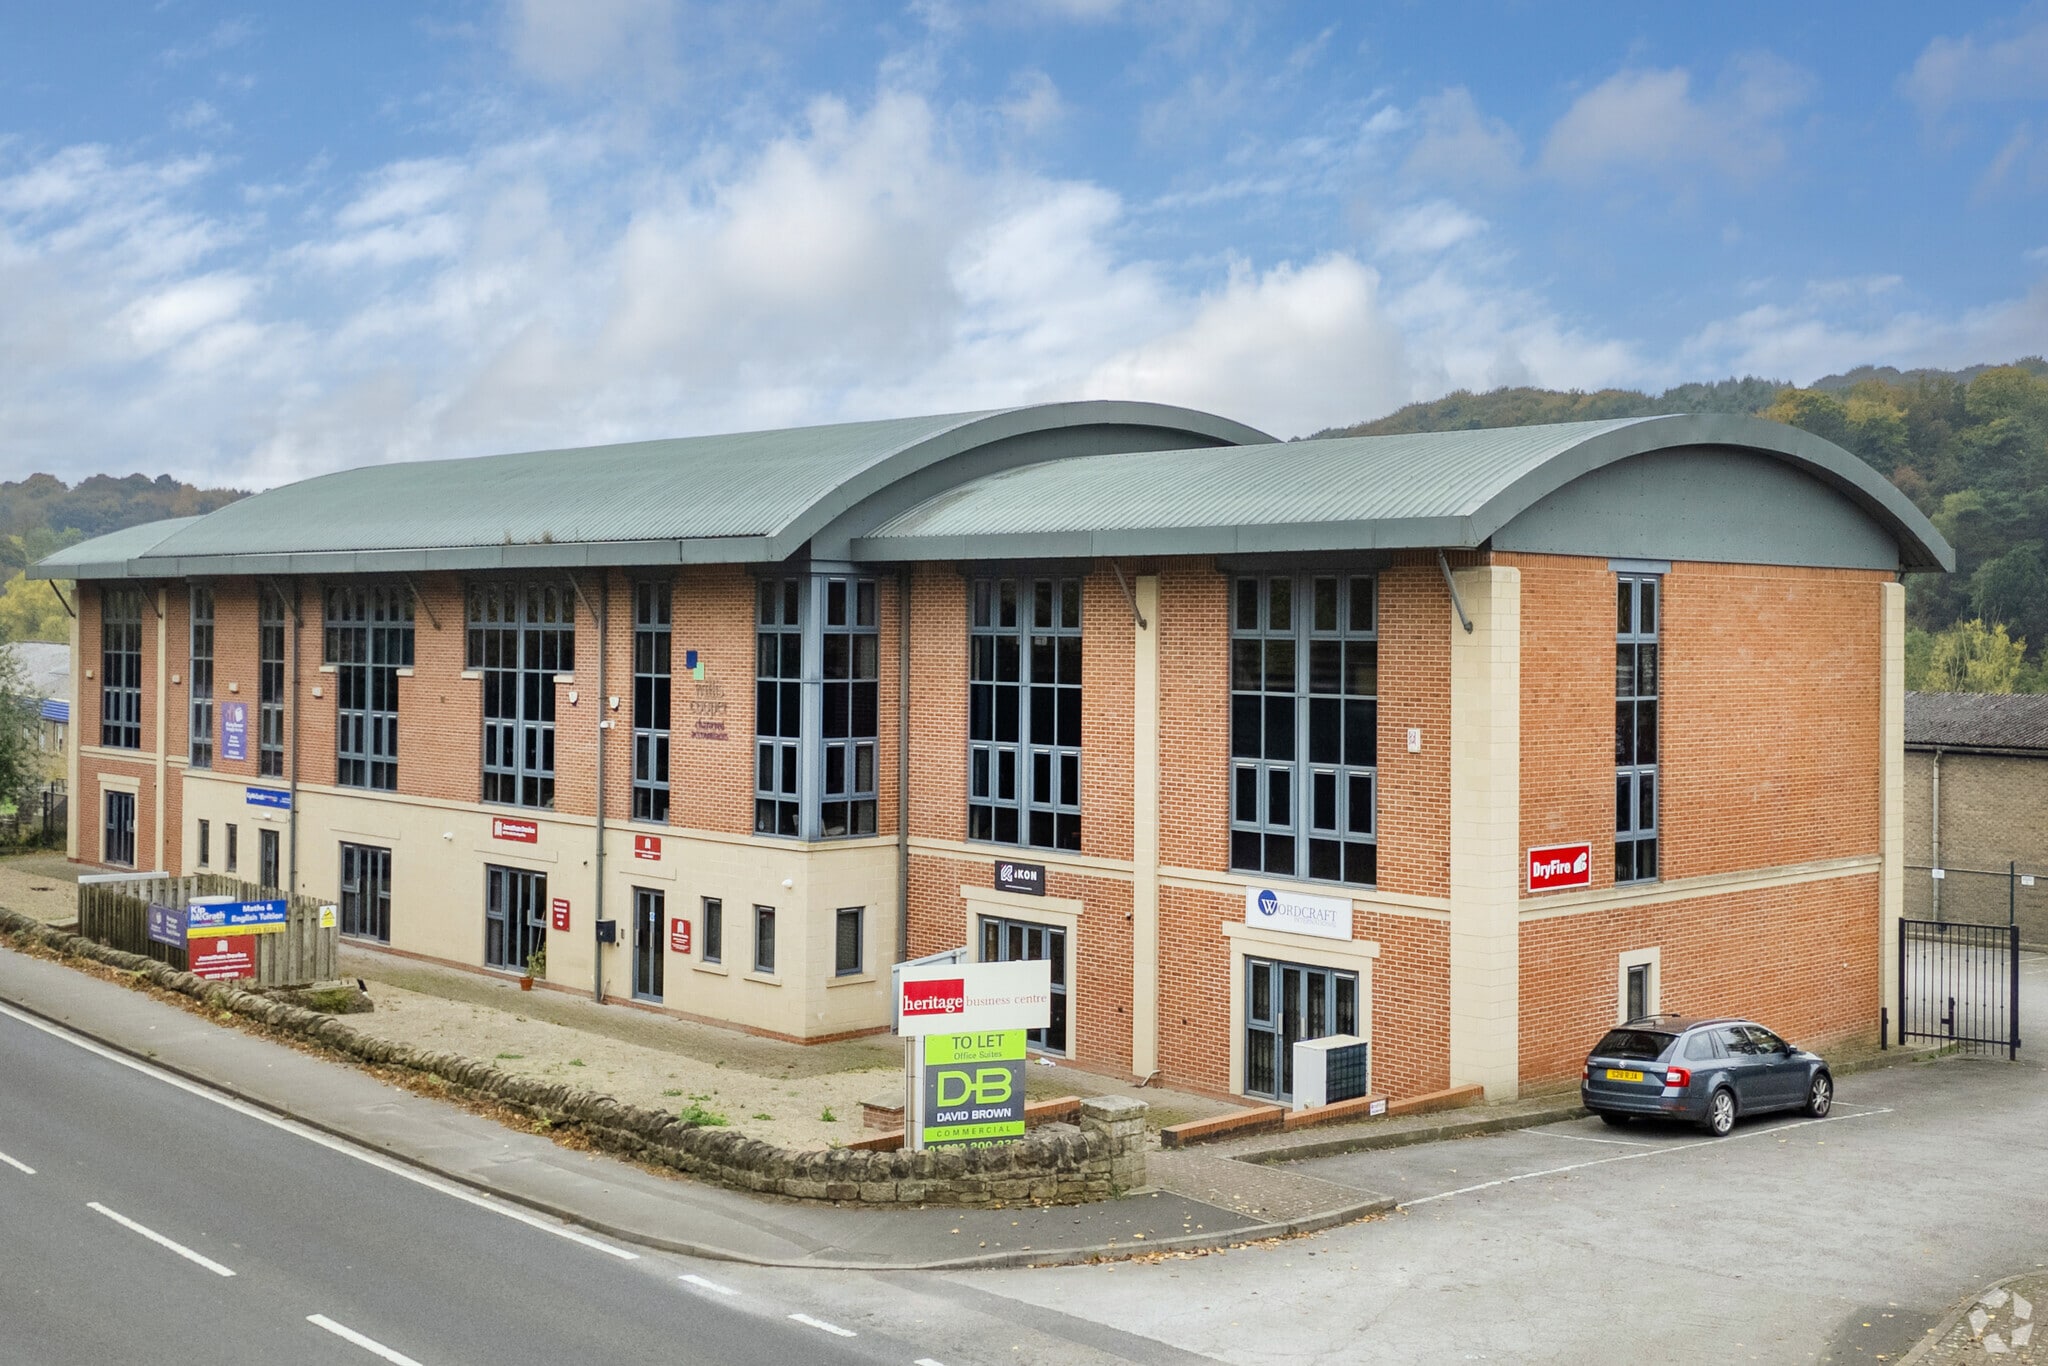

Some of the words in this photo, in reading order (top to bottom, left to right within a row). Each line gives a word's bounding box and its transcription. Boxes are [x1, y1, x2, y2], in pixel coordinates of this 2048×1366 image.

[1533, 859, 1571, 879] DryFire
[190, 905, 206, 914] Kip
[242, 904, 265, 913] Maths
[266, 903, 274, 911] &
[1261, 898, 1337, 922] WORDCRAFT
[190, 911, 226, 921] McGrath
[231, 914, 258, 923] English
[259, 912, 284, 920] Tuition
[903, 995, 963, 1013] heritage
[966, 995, 1010, 1007] business
[1014, 994, 1047, 1004] centre
[952, 1036, 972, 1049] TO
[977, 1034, 1005, 1048] LET
[954, 1052, 977, 1060] Office
[979, 1050, 1003, 1059] Suites
[937, 1111, 969, 1122] DAVID
[971, 1108, 1012, 1120] BROWN
[936, 1125, 1012, 1137] COMMERCIAL
